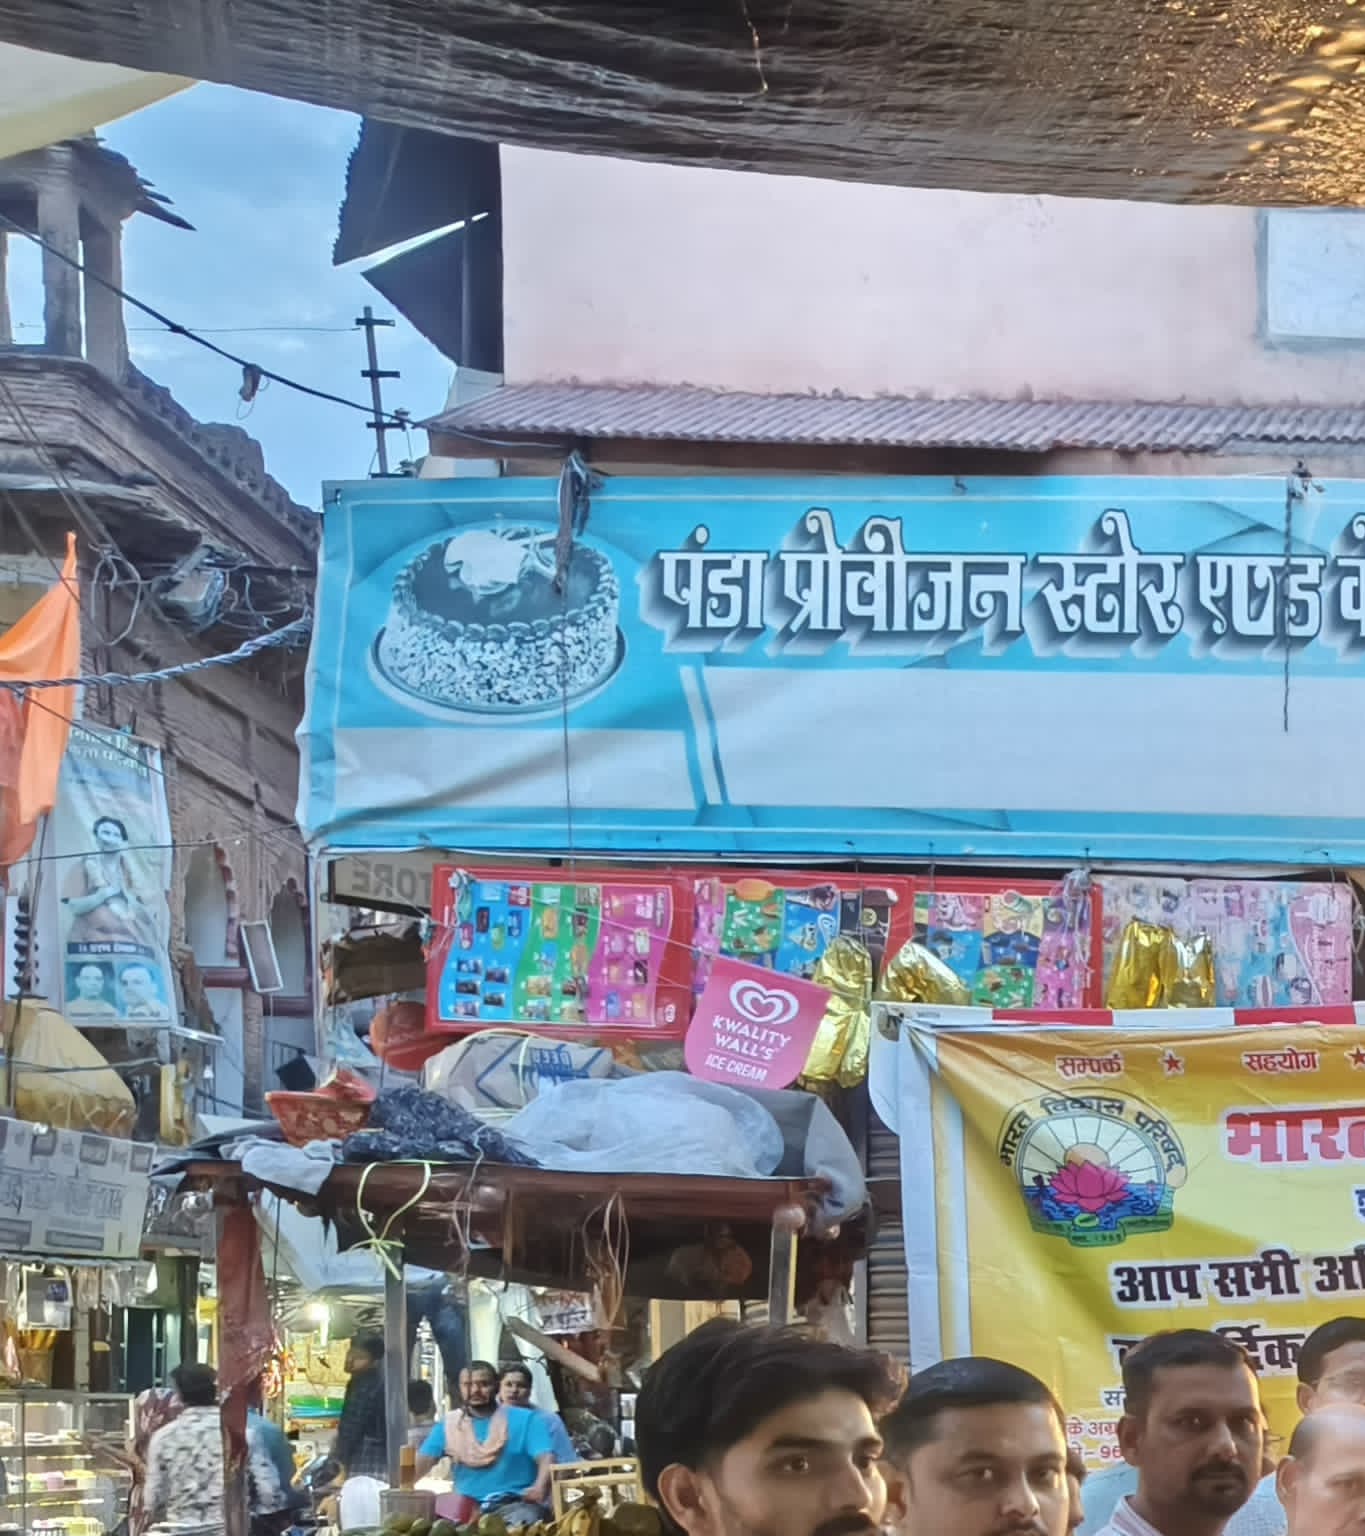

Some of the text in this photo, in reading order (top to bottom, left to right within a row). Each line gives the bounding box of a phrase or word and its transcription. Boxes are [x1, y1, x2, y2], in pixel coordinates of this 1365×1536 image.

[657, 524, 770, 634] पंडा
[1038, 507, 1186, 637] स्टोर
[712, 1015, 793, 1047] KWALITY
[714, 1033, 780, 1060] WALL'S
[1243, 1048, 1319, 1072] सहयोग
[704, 1053, 769, 1082] ICE CREAM
[1114, 1261, 1201, 1303] आप
[1208, 1248, 1301, 1297] सभी
